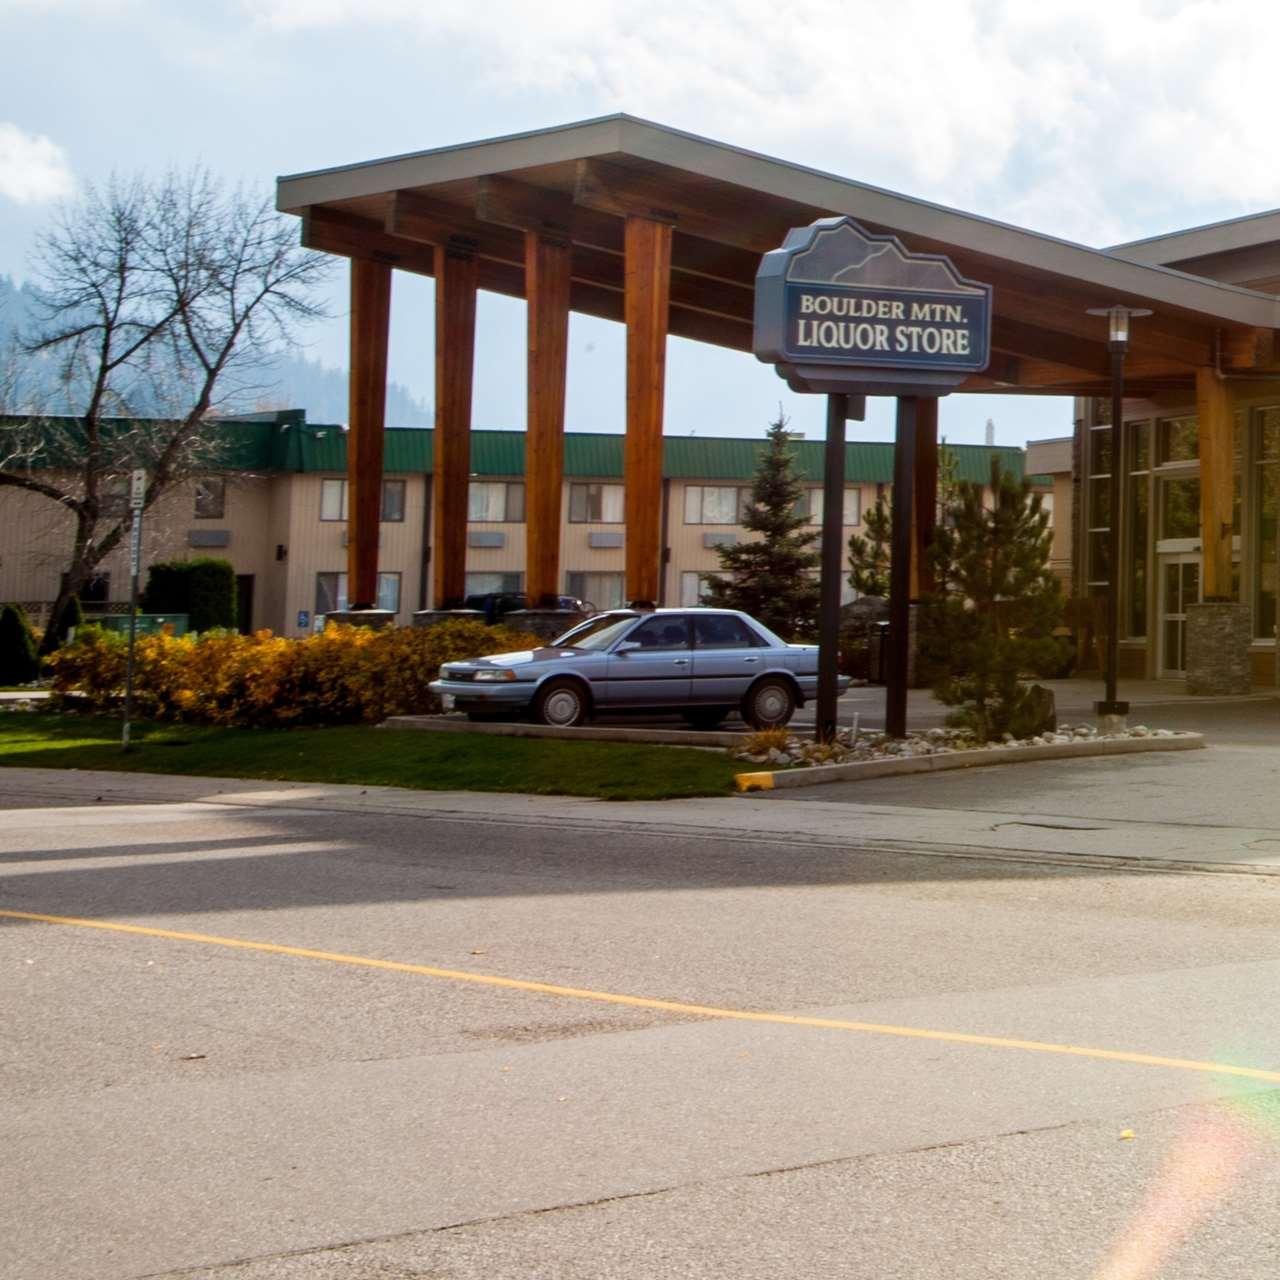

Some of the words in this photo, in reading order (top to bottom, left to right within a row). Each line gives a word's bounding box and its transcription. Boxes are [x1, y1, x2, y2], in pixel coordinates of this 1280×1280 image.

[801, 295, 905, 320] BOULDER
[911, 303, 968, 323] MTN.
[797, 320, 891, 350] LIQUOR
[895, 326, 970, 355] STORE
